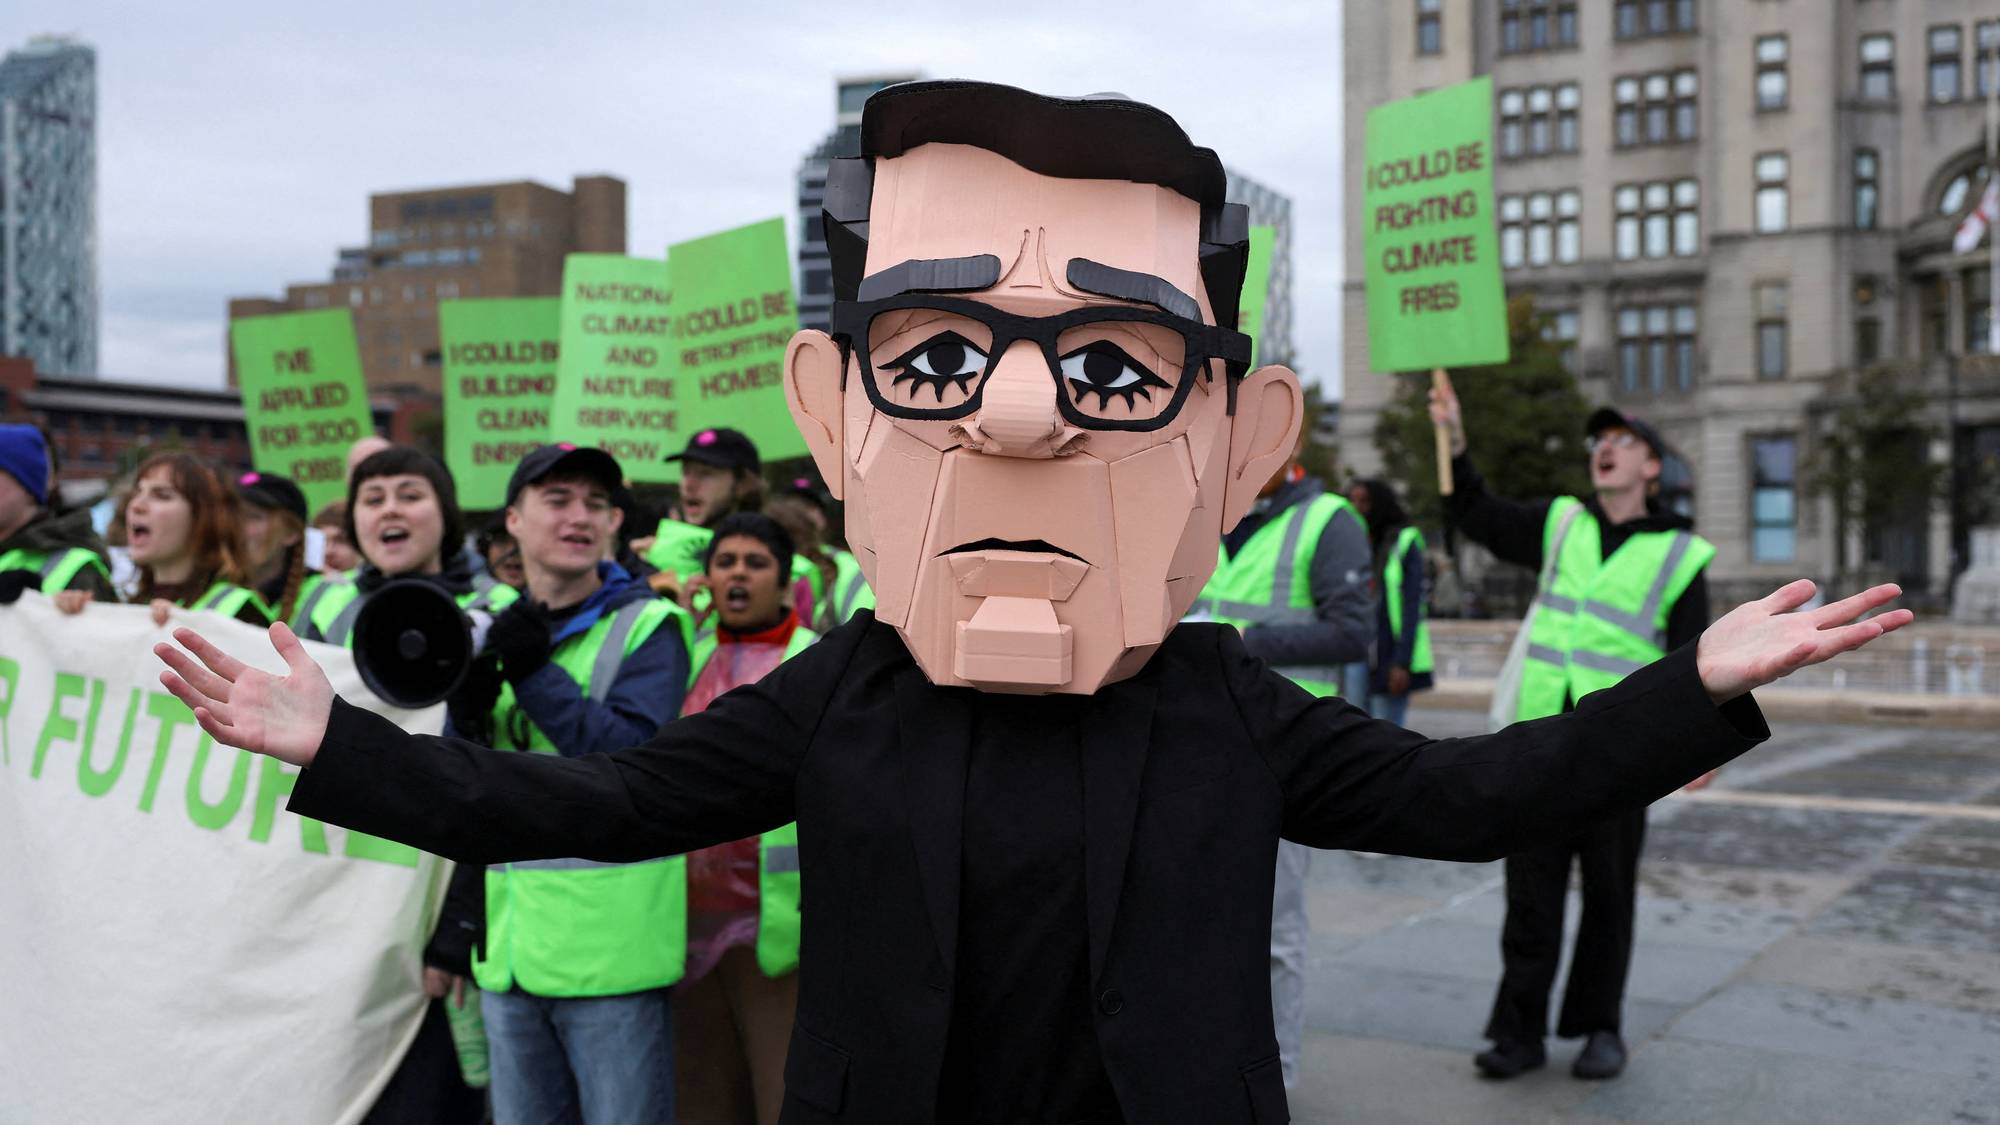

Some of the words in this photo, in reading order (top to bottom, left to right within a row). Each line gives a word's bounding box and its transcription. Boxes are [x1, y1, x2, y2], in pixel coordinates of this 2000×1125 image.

[1368, 165, 1375, 191] I
[1377, 148, 1450, 190] COULD
[1455, 141, 1485, 173] BE
[1376, 190, 1477, 232] FIGHTING
[1382, 235, 1477, 274] CLIMATE
[576, 282, 673, 305] NATION
[1400, 281, 1461, 316] FIRES
[582, 314, 670, 336] CLIMAT
[686, 298, 759, 336] COULD
[761, 290, 790, 319] BE
[461, 341, 537, 365] COULD
[607, 347, 657, 368] AND
[583, 376, 674, 400] NATURE
[701, 360, 782, 399] HOMES
[259, 381, 349, 413] APPLIED
[259, 423, 299, 450] FOR
[305, 416, 360, 446] 300
[478, 408, 549, 431] CLEAN
[577, 407, 678, 432] SERVICE
[472, 441, 543, 465] ENER
